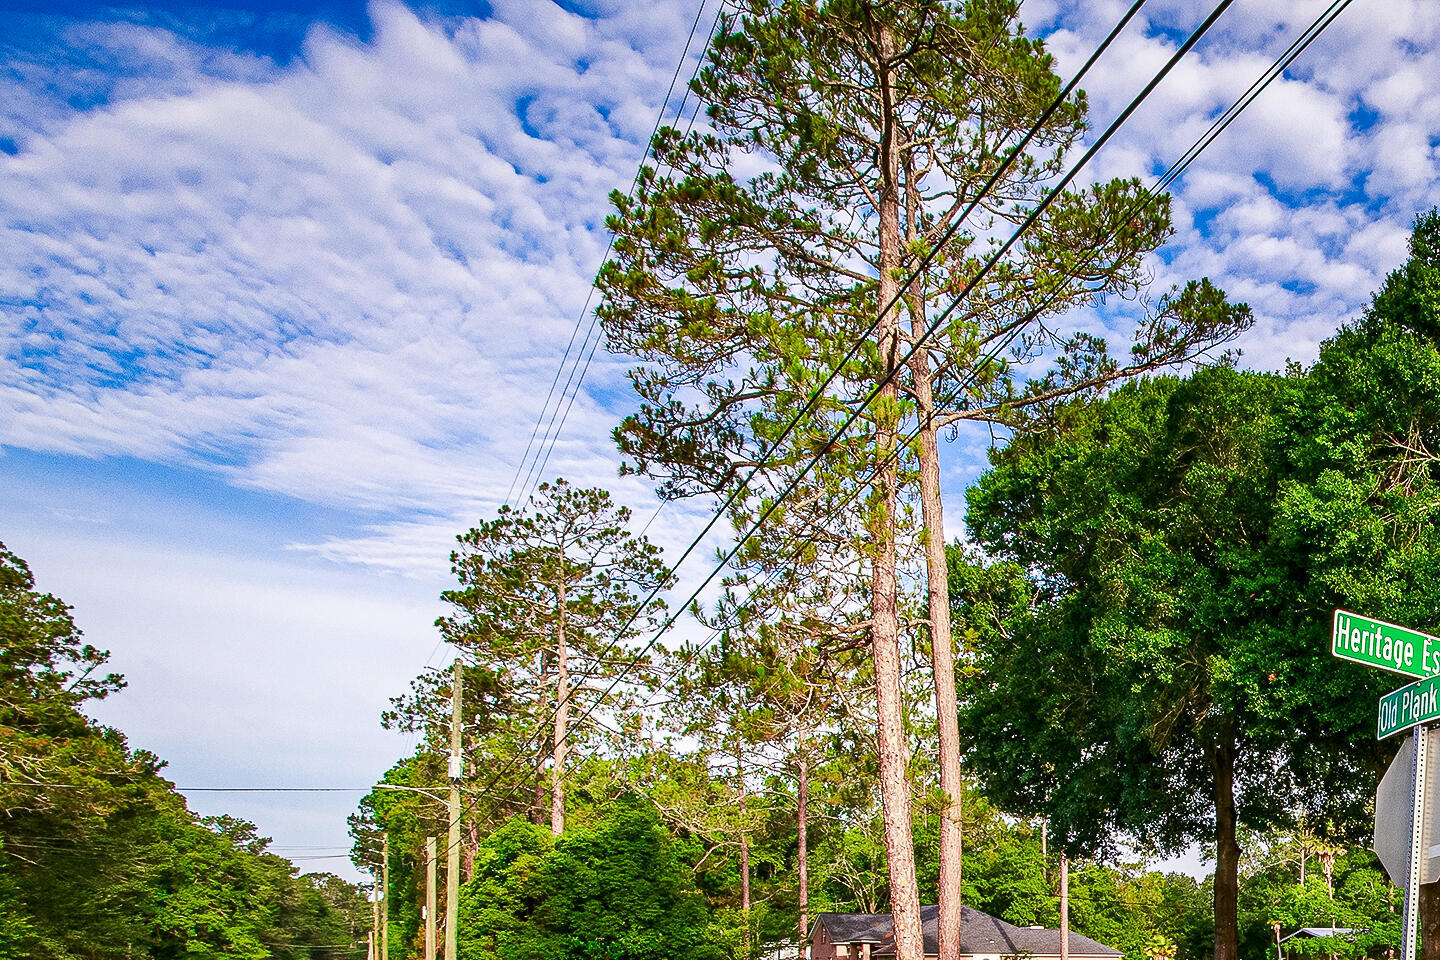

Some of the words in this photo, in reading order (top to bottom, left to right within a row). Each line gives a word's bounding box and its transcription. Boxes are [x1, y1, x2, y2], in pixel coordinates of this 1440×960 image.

[1337, 615, 1414, 669] Heritage
[1380, 696, 1399, 733] Old
[1401, 682, 1438, 723] Plank
